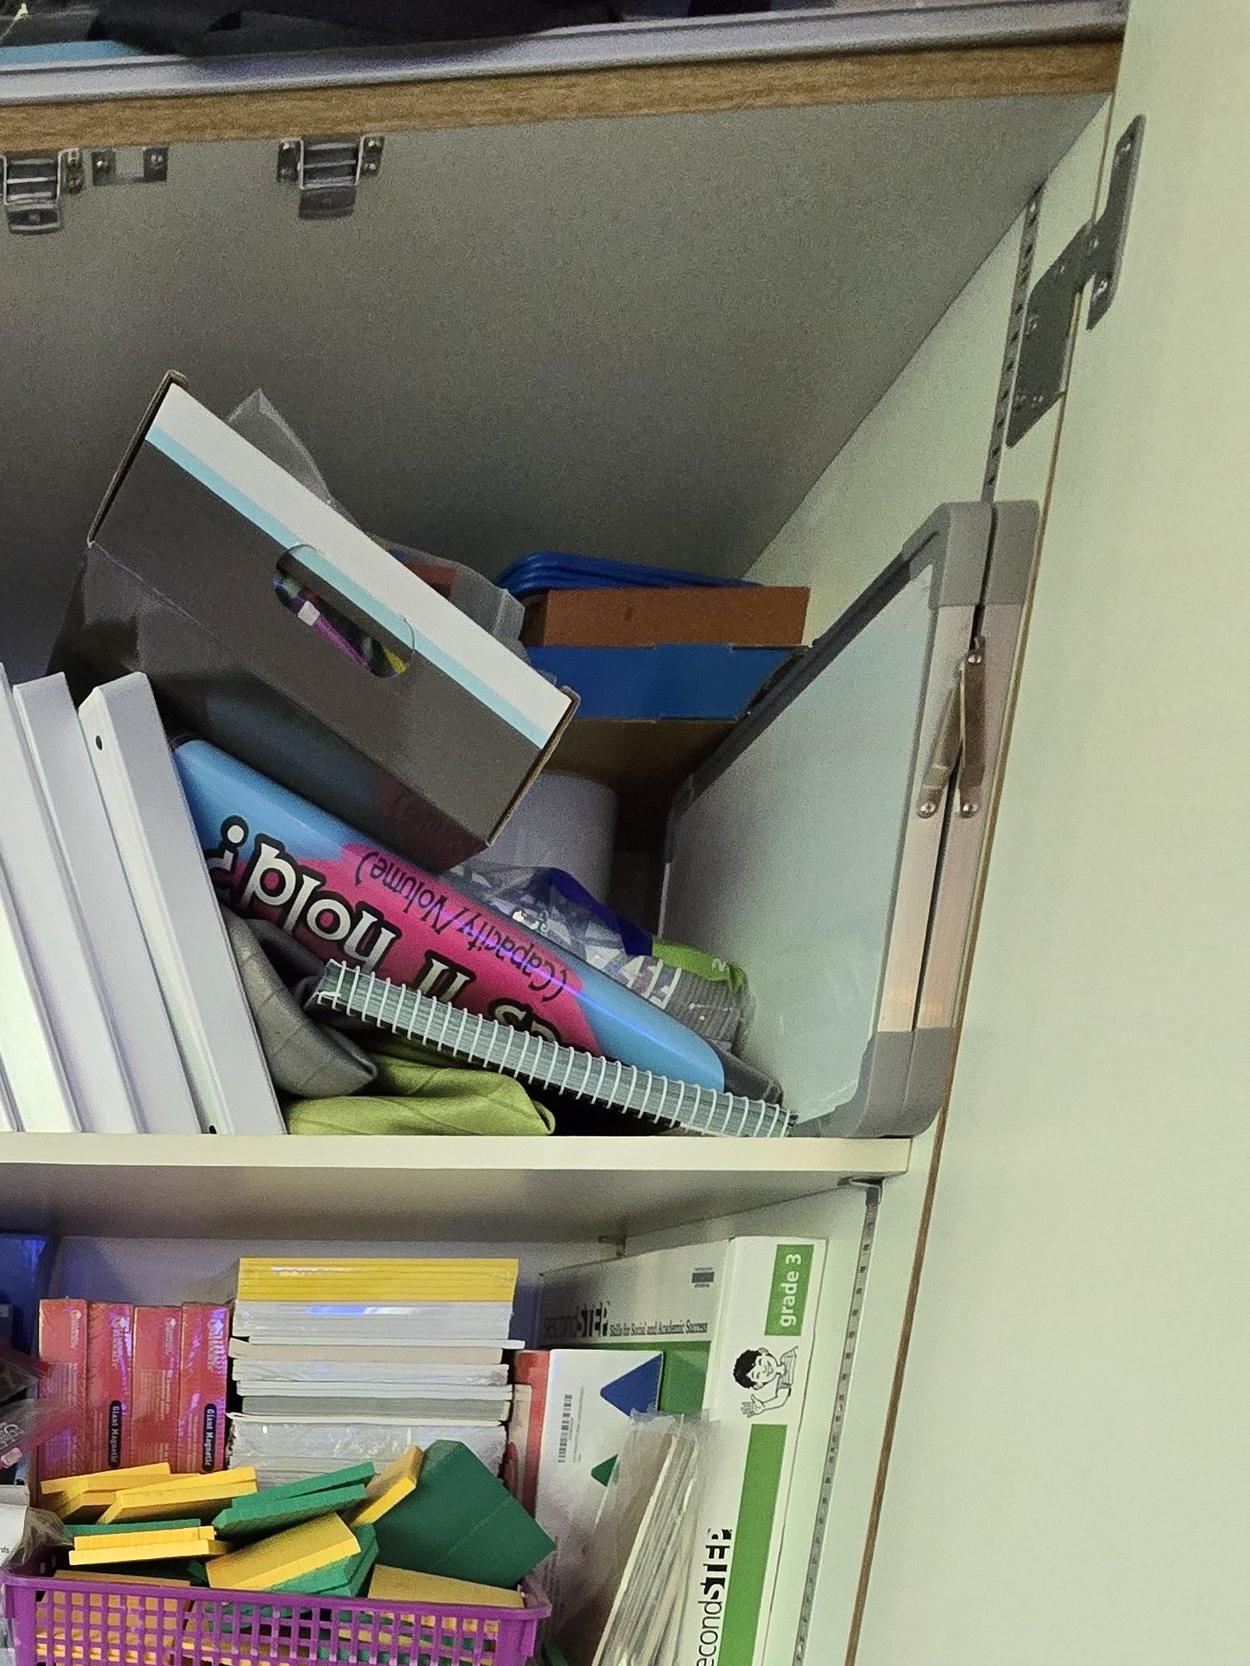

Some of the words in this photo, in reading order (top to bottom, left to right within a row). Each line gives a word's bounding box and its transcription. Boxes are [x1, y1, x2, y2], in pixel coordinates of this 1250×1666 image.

[785, 1253, 802, 1265] 3
[779, 1271, 799, 1328] grade
[686, 1319, 709, 1333] Success
[111, 1404, 120, 1427] Giant
[206, 1408, 216, 1430] Giant
[108, 1429, 119, 1463] Magnetic
[203, 1432, 214, 1466] Magnetic
